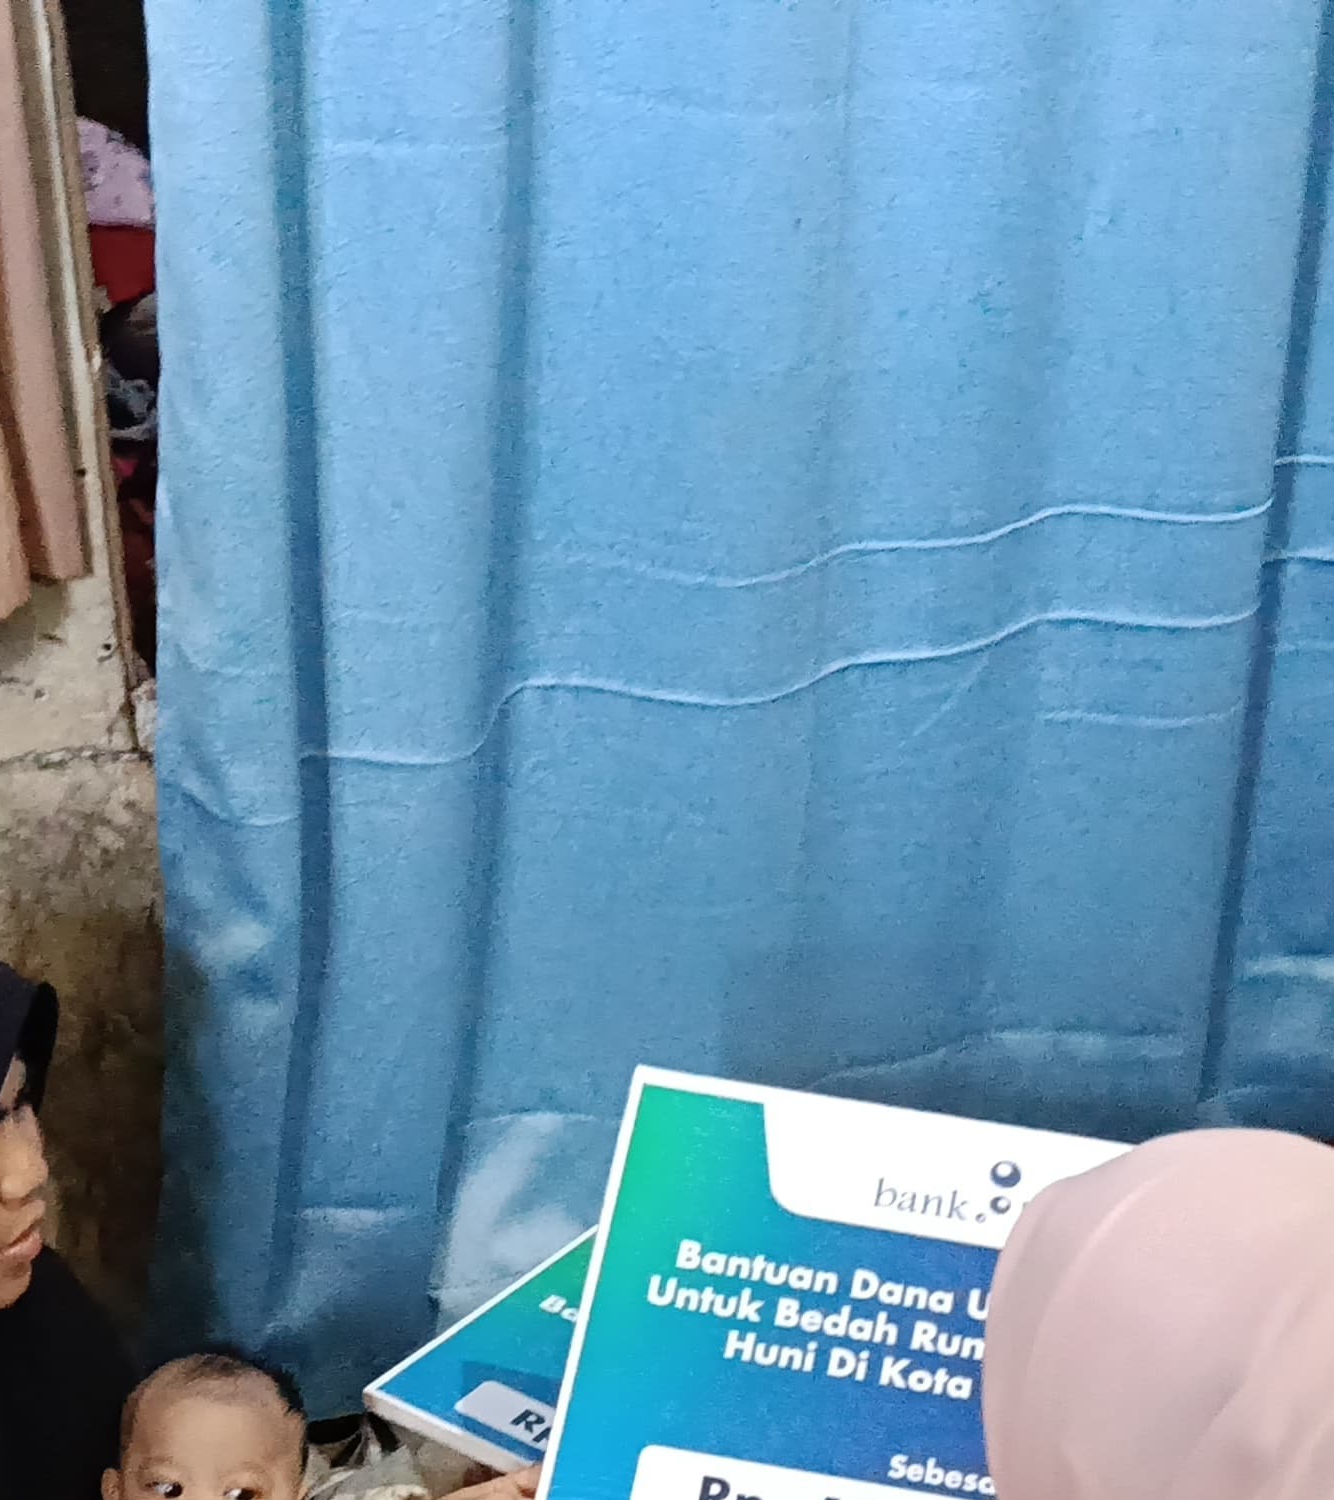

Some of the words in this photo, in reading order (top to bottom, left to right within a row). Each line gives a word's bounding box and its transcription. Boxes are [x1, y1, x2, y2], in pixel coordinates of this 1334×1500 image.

[873, 1176, 969, 1222] bank
[646, 1274, 765, 1323] Untuk
[774, 1296, 899, 1347] Bedah
[675, 1239, 839, 1295] Bantuan
[849, 1268, 955, 1314] Dana
[722, 1329, 818, 1373] Huni
[826, 1346, 870, 1382] Di
[878, 1355, 974, 1401] Kota
